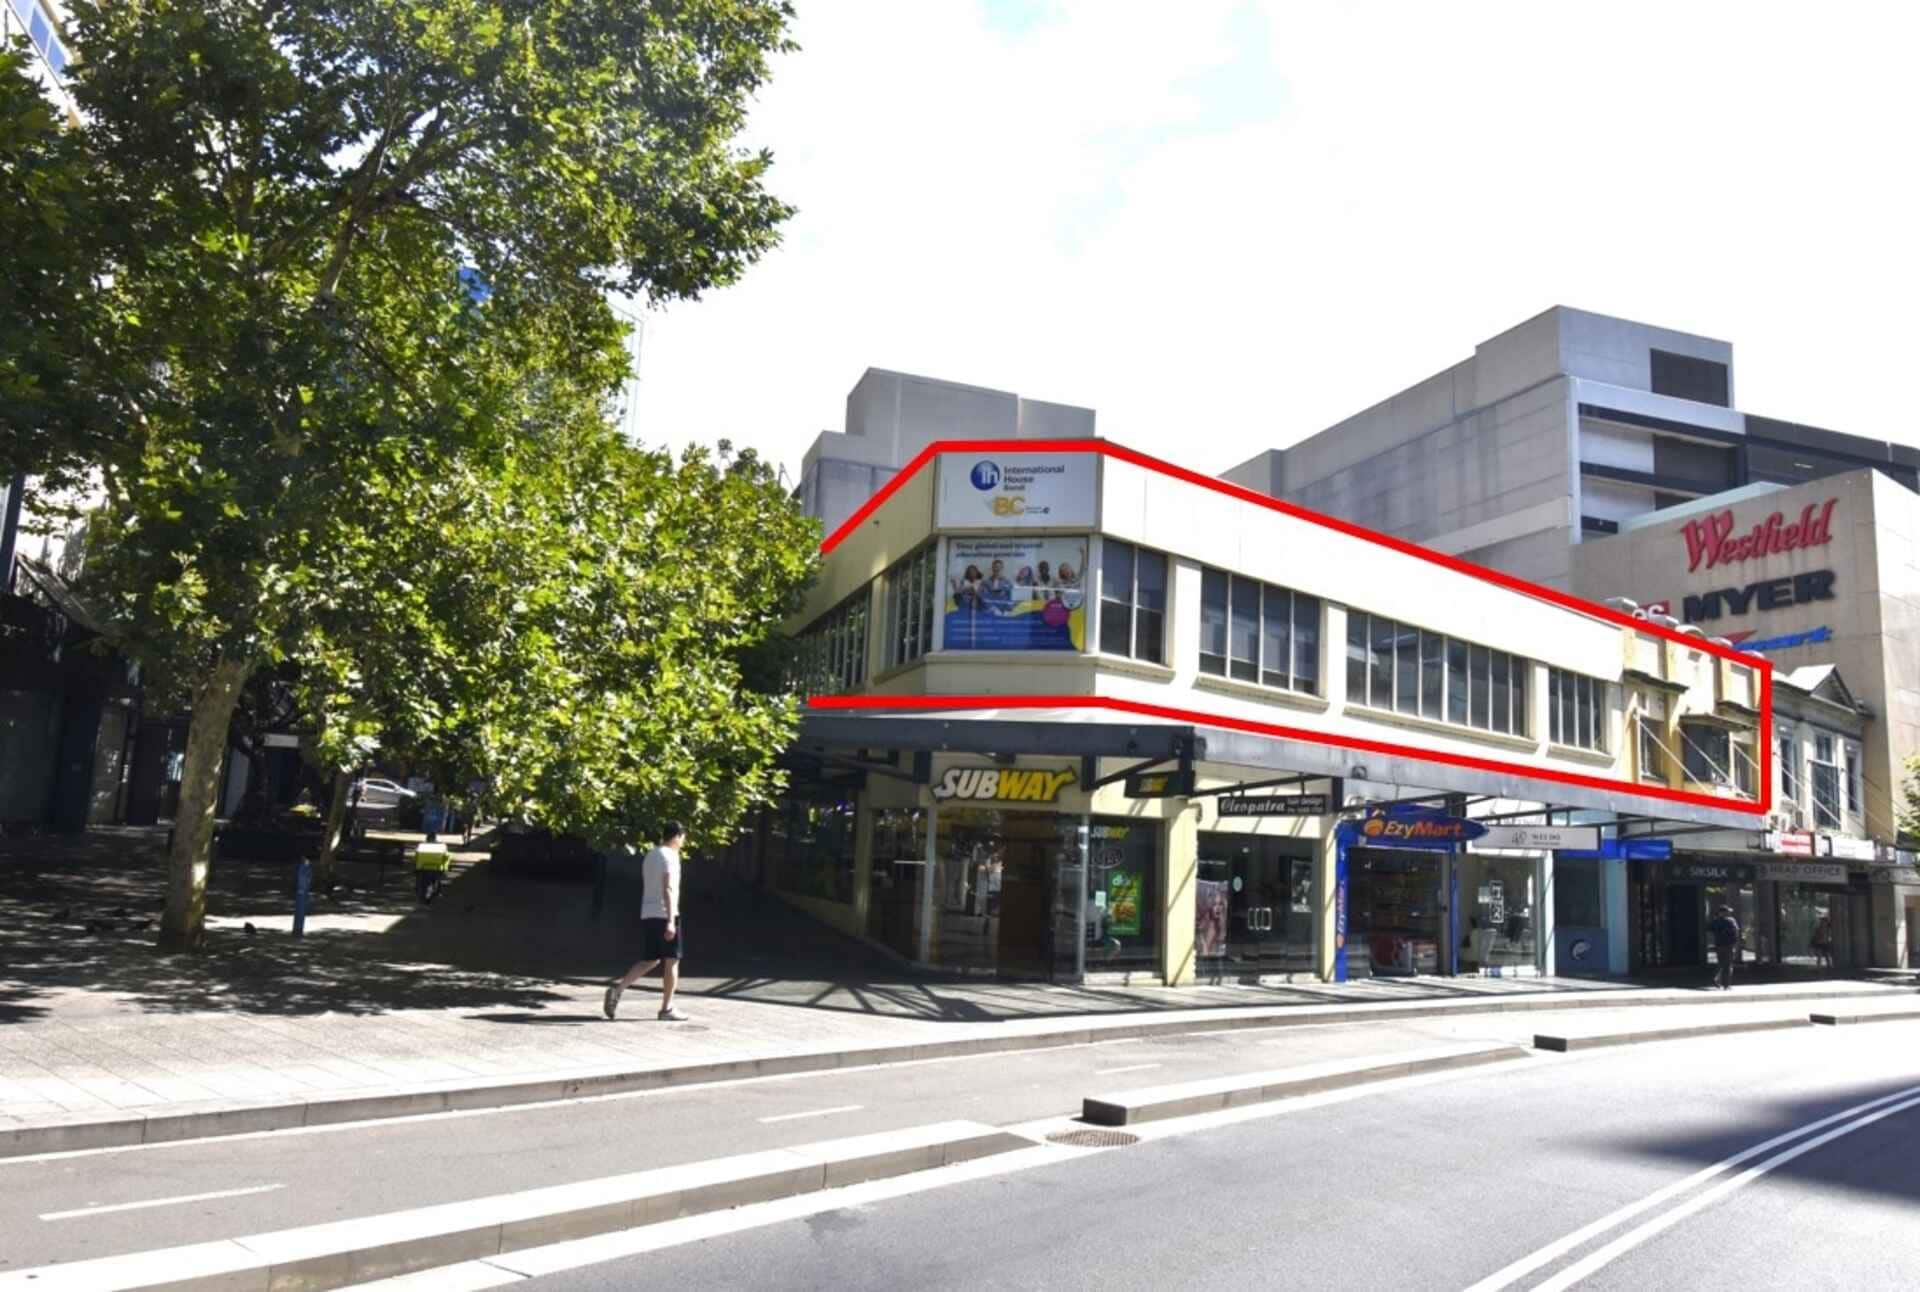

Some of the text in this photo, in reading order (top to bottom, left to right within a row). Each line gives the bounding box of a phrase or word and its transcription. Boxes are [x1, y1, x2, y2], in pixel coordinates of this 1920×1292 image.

[1003, 464, 1065, 475] International
[1003, 476, 1035, 484] House
[992, 496, 1025, 517] BC
[1679, 497, 1839, 573] Westfield
[1682, 569, 1836, 623] MYER
[933, 767, 1076, 801] SUBWAY
[1221, 798, 1286, 815] Cleopatra
[1383, 820, 1464, 839] EzyMart
[1803, 865, 1842, 877] OFFICE
